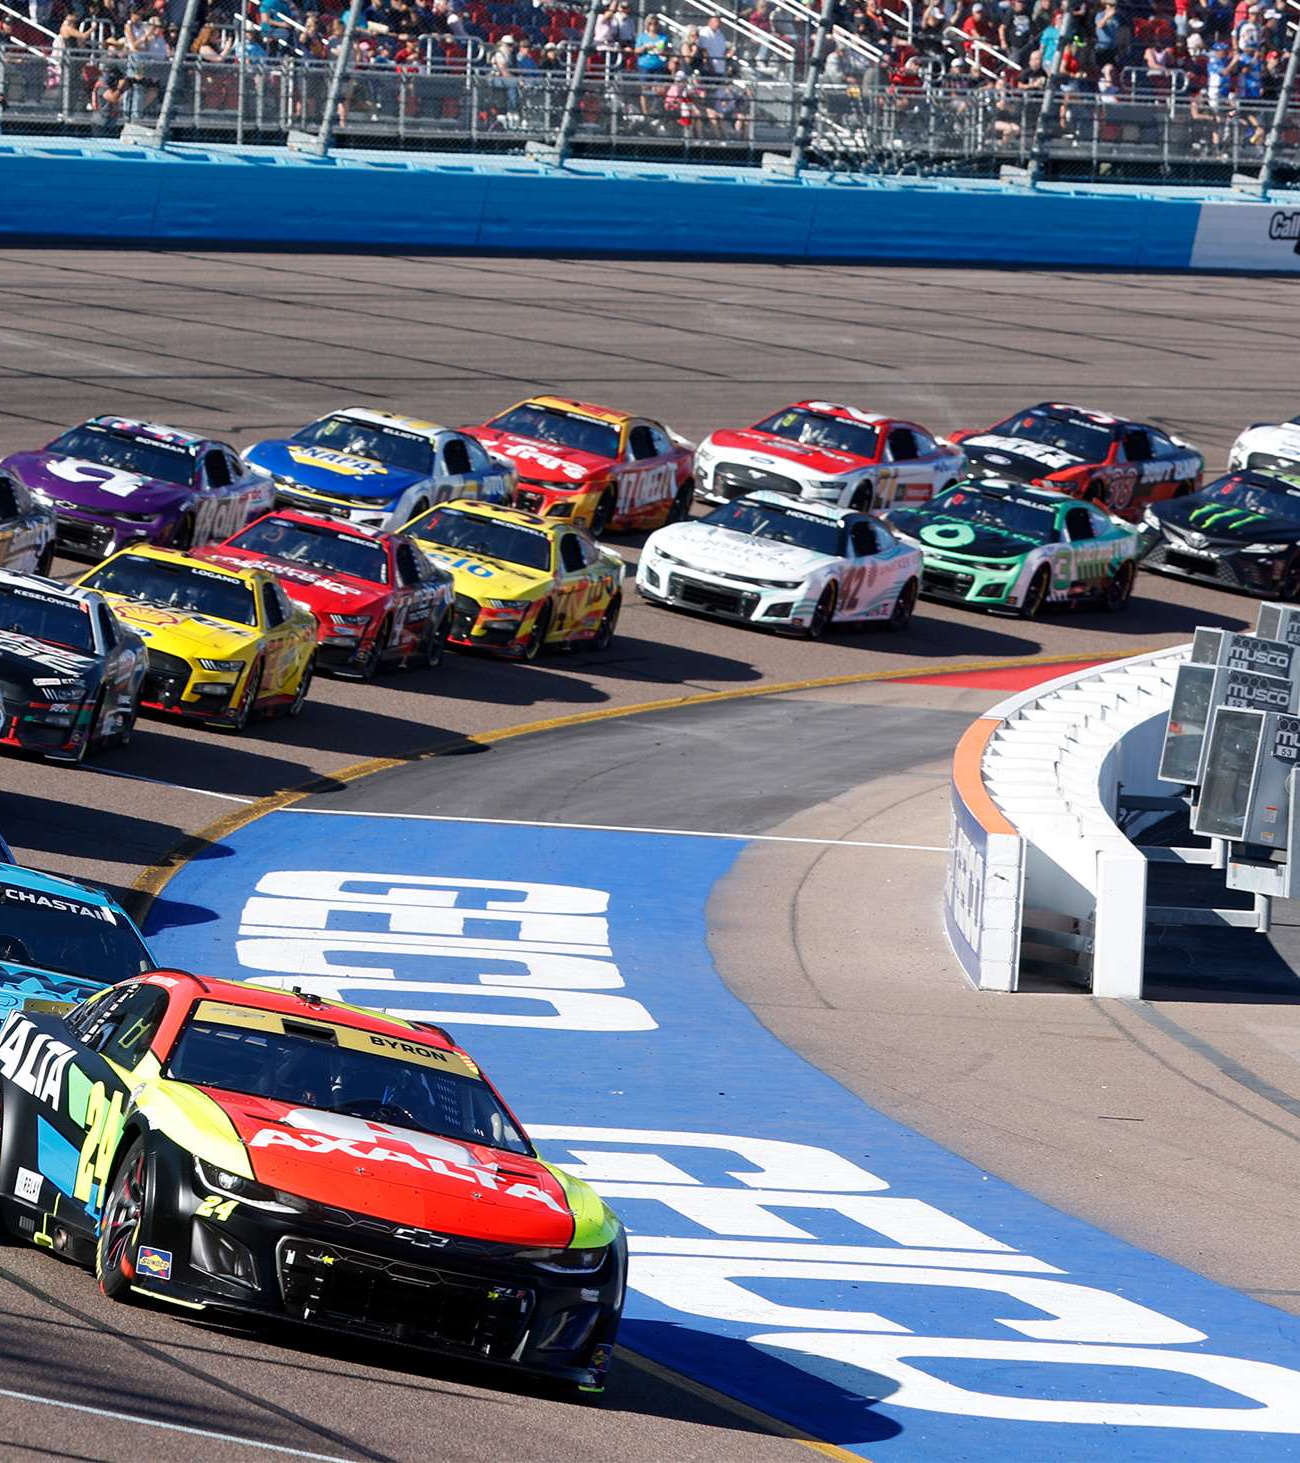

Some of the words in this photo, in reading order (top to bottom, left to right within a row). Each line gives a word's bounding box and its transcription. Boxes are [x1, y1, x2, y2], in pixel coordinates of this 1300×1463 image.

[134, 436, 186, 454] BOWMAN
[382, 427, 425, 442] ELLIOTT
[191, 568, 241, 585] LOGANO
[14, 588, 83, 611] KESELOWSK
[4, 888, 111, 923] CHASTAI
[369, 1034, 447, 1063] BYRON
[249, 1128, 568, 1215] AXALTA
[195, 1195, 240, 1222] 24
[139, 1256, 171, 1270] SUNOCO
